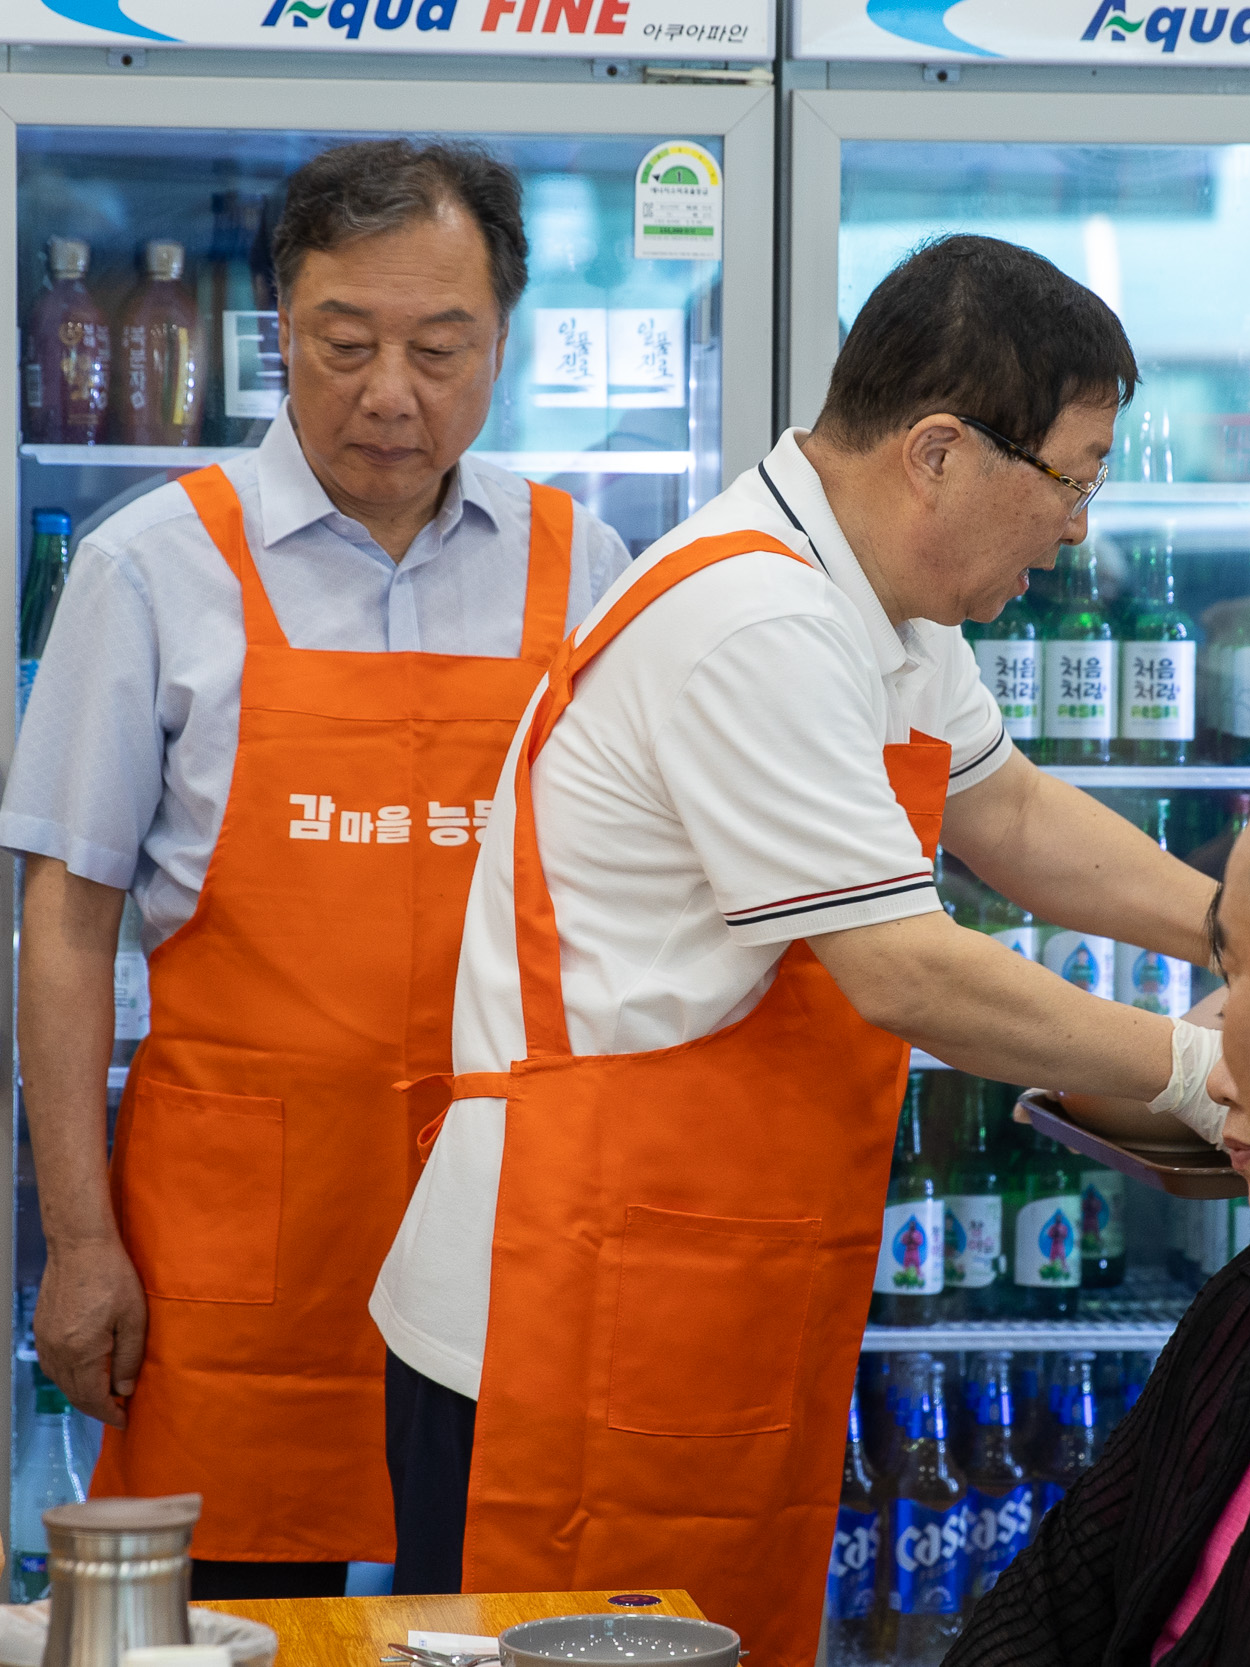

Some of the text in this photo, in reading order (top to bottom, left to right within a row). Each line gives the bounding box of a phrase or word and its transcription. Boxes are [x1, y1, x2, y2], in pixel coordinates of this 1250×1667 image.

[480, 0, 629, 35] FINE
[643, 23, 748, 44] 아쿠아파인
[1060, 656, 1103, 680] 처음
[1134, 657, 1176, 680] 처음
